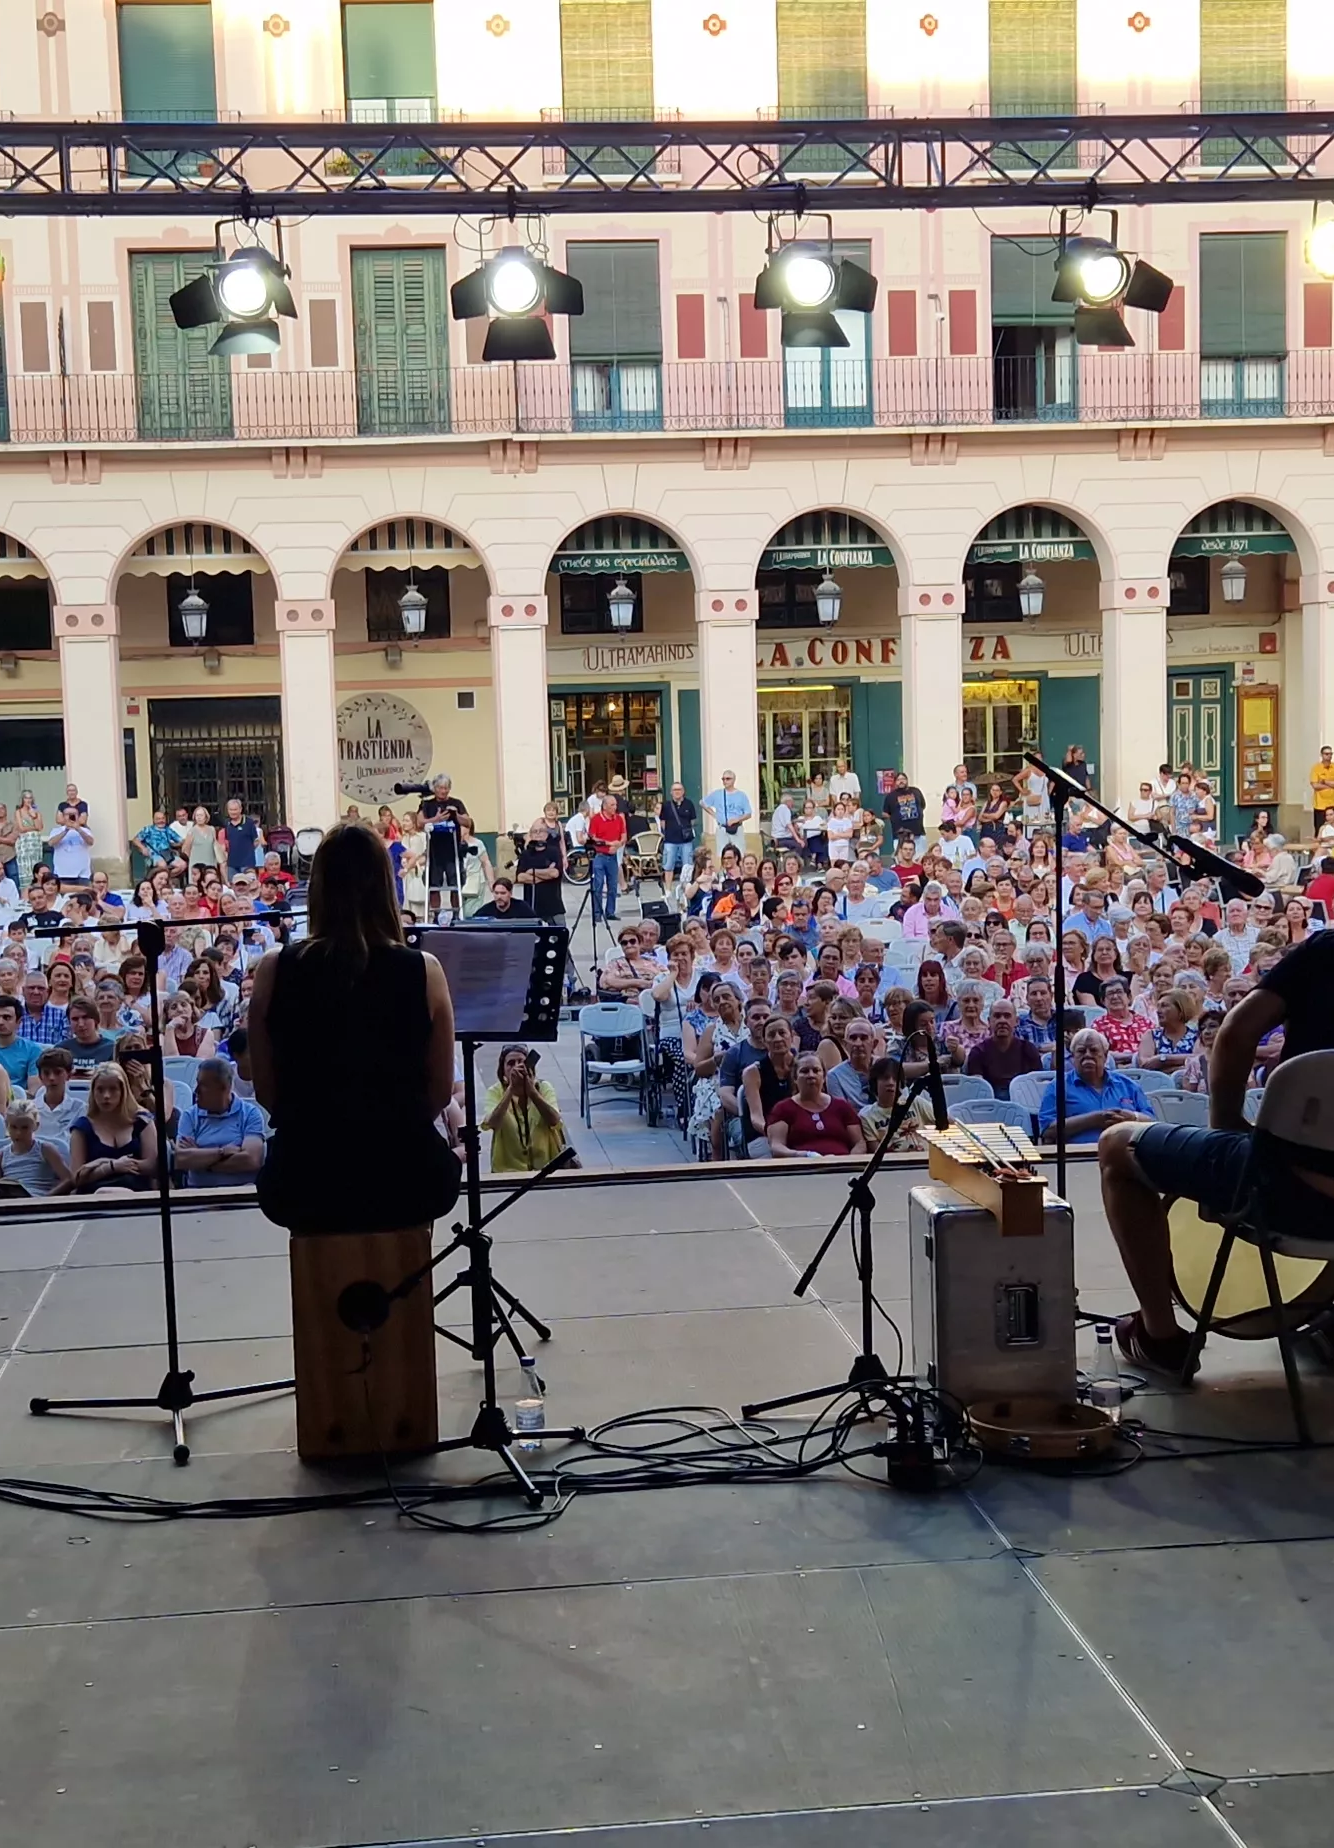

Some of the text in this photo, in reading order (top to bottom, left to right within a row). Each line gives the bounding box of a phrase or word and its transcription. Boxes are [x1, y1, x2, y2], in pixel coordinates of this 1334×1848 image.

[1019, 543, 1029, 560] LA
[1031, 543, 1075, 559] CONFIANZA
[1229, 538, 1249, 551] 1871
[595, 558, 610, 568] sus
[817, 549, 828, 566] LA
[829, 549, 874, 566] CONFIANZA
[586, 643, 695, 671] ULTRAMARINOS
[367, 716, 383, 739] LA
[337, 737, 414, 760] TRASTIENDA
